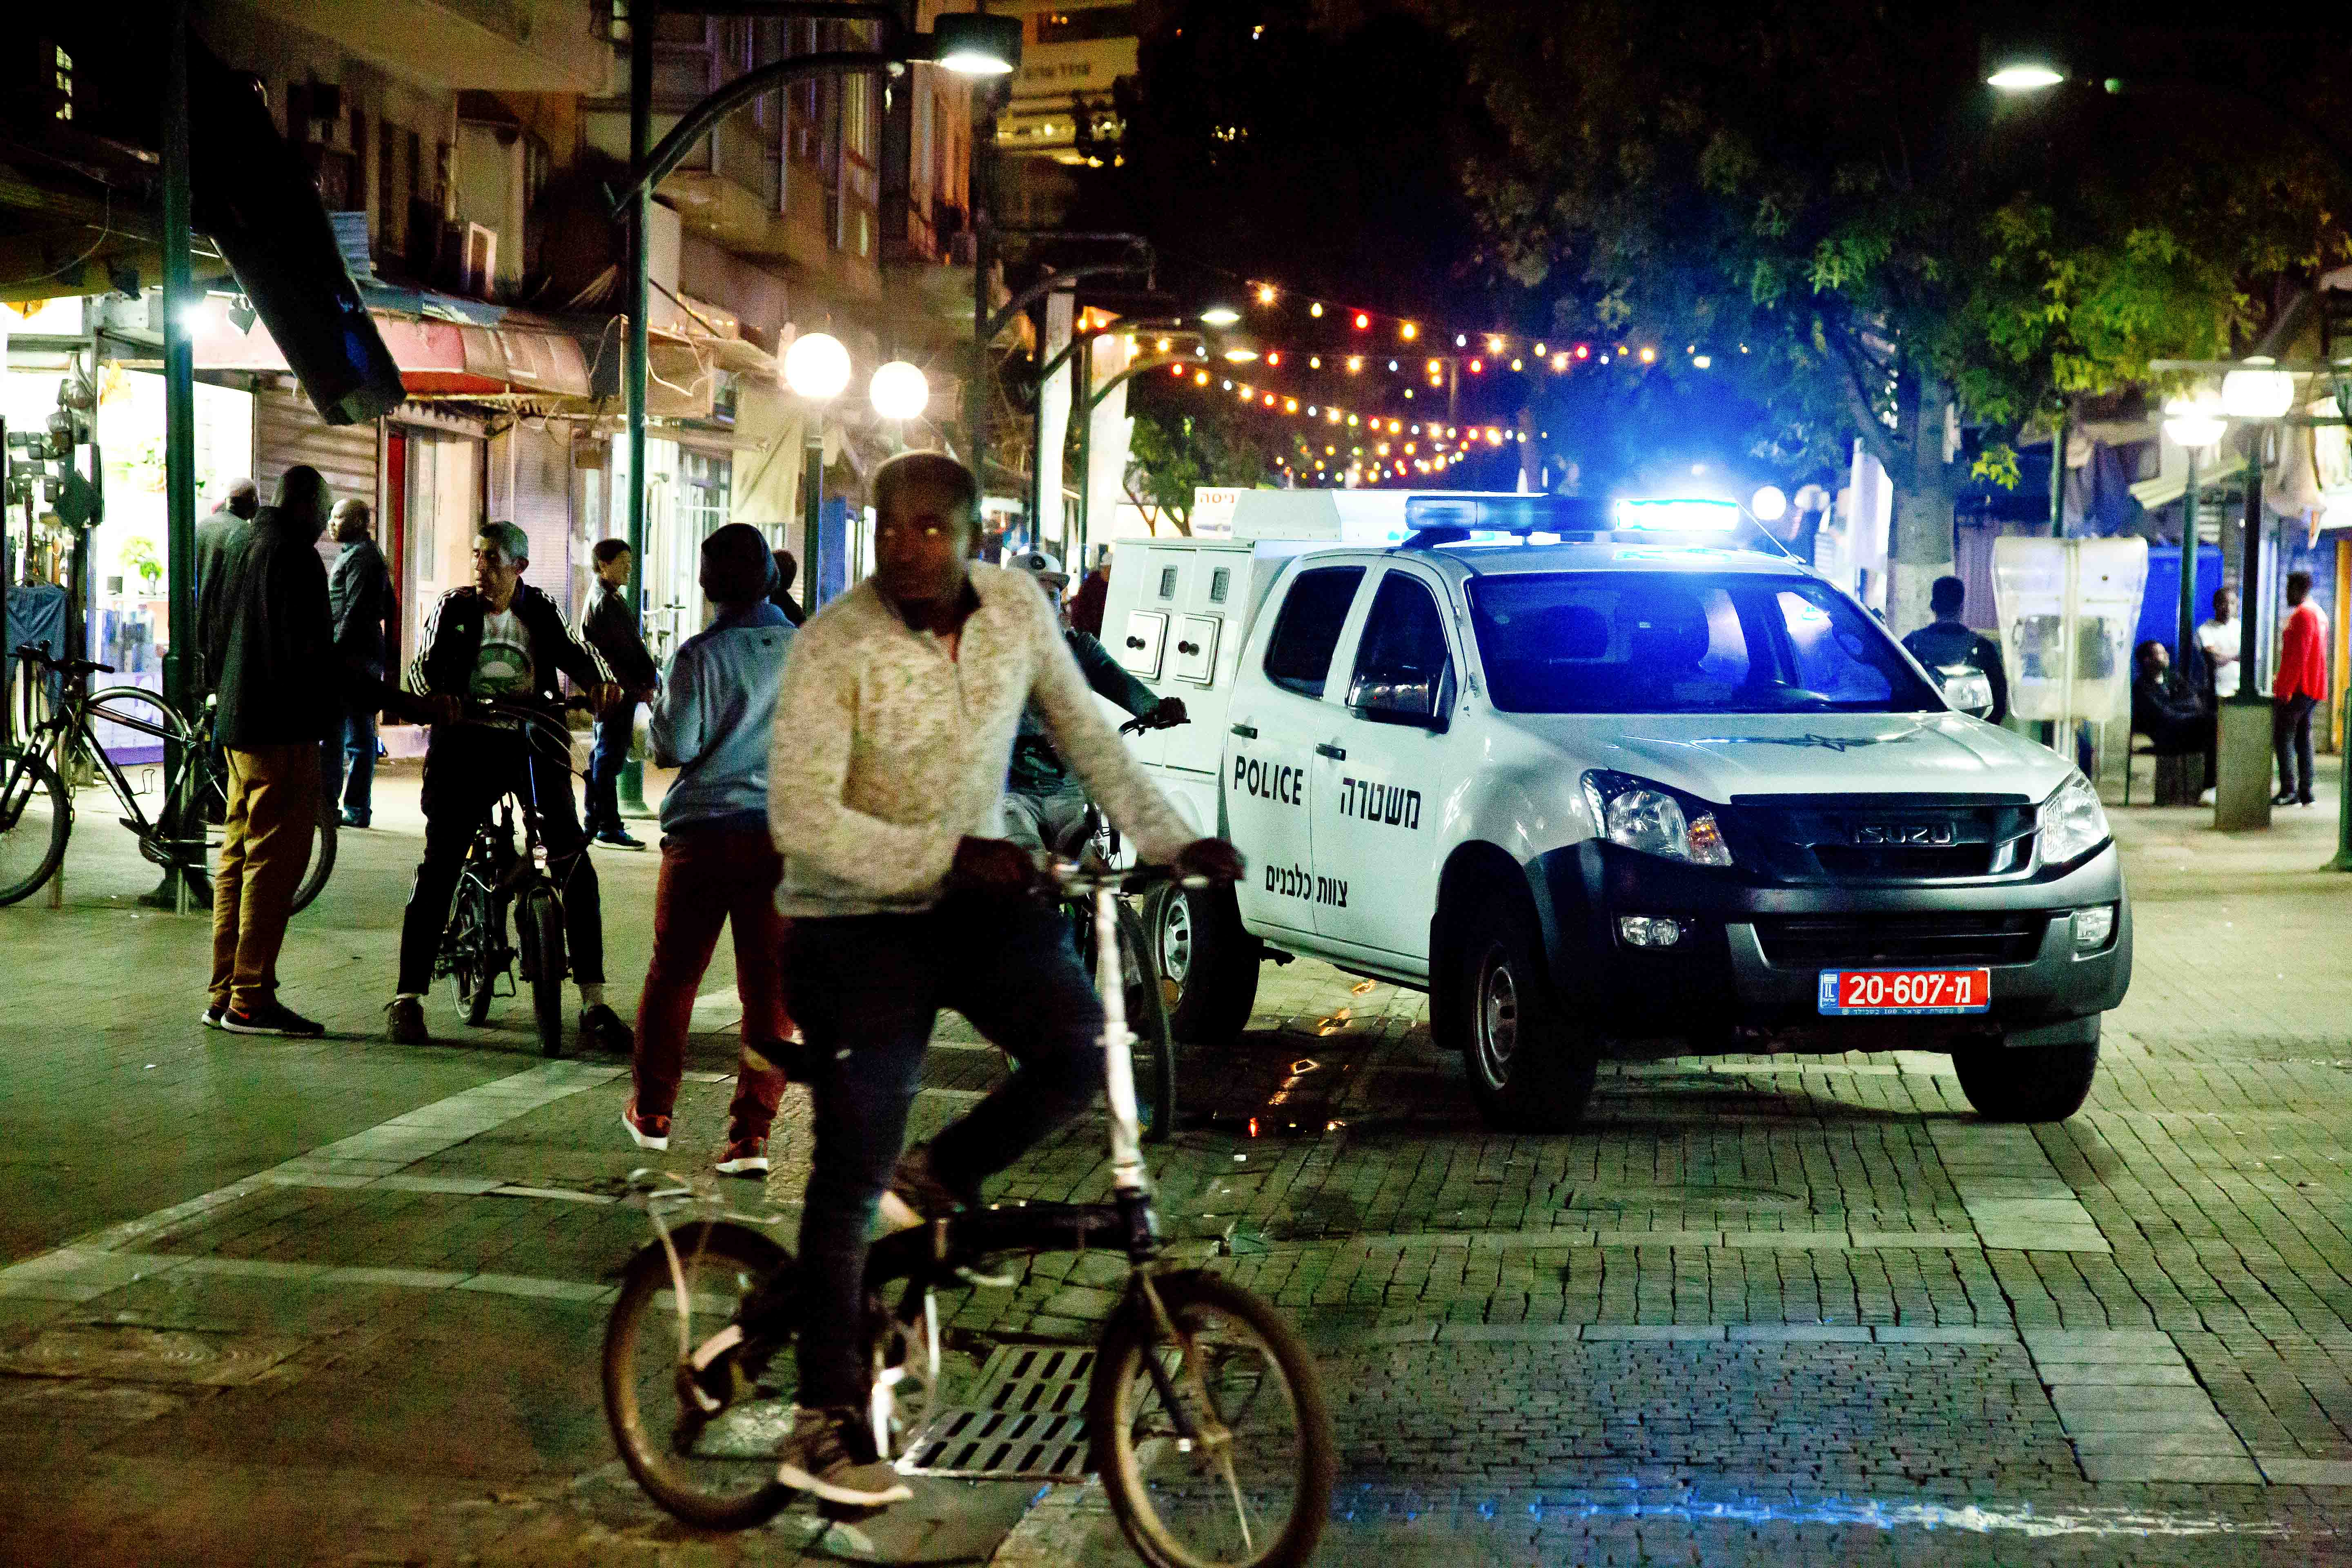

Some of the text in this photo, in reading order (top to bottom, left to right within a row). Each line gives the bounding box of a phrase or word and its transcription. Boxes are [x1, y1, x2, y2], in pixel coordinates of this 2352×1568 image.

[1200, 493, 1234, 503] ניסה
[1234, 755, 1304, 806] POLICE
[1341, 777, 1421, 830] משטרה
[1854, 826, 1951, 843] ISUZU
[1266, 862, 1348, 908] צוות כלבנים
